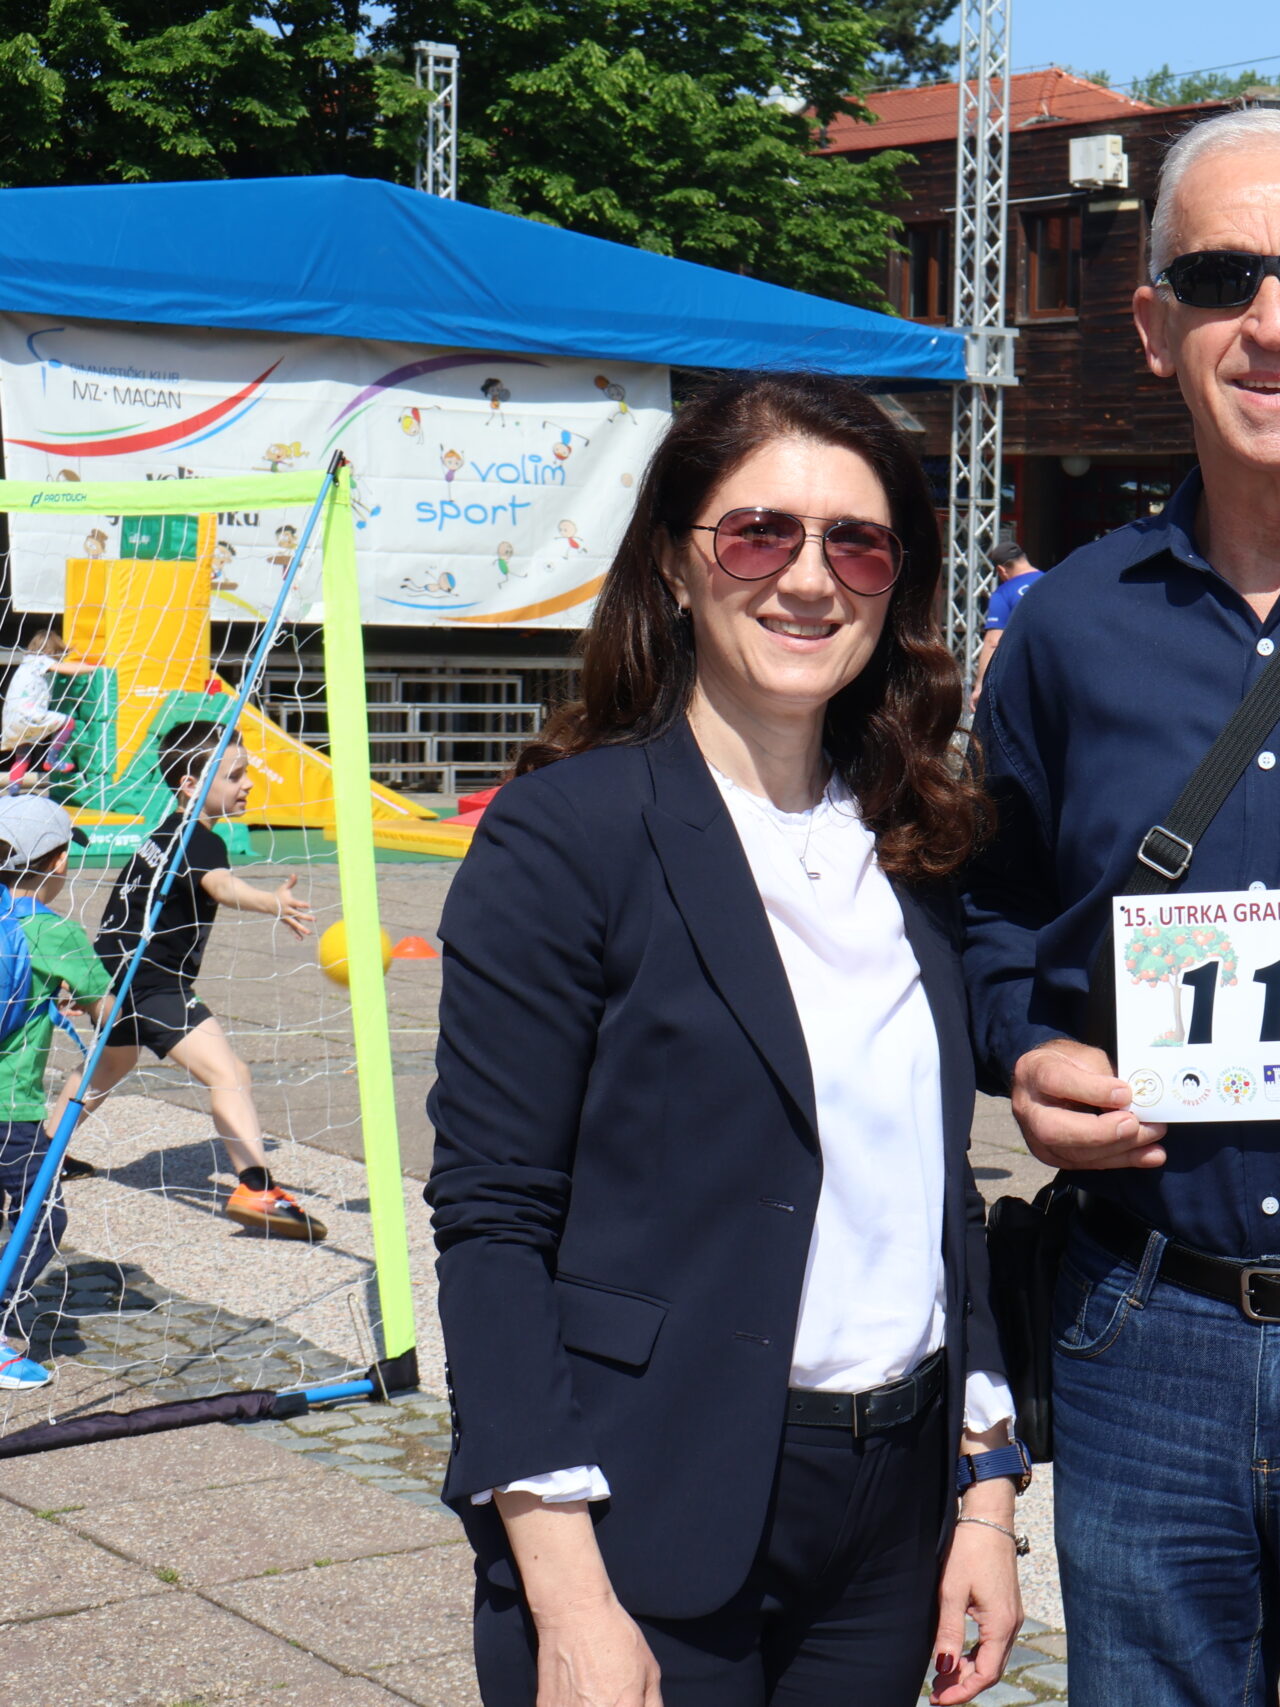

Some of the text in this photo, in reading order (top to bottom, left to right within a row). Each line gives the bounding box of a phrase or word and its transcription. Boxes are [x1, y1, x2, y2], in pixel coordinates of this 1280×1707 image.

[149, 370, 180, 384] KLUB
[112, 385, 182, 410] MACAN
[470, 454, 566, 486] volim
[61, 493, 87, 503] TOUCH
[416, 495, 531, 532] sport
[1123, 907, 1153, 927] 15.
[1159, 904, 1227, 926] UTRKA
